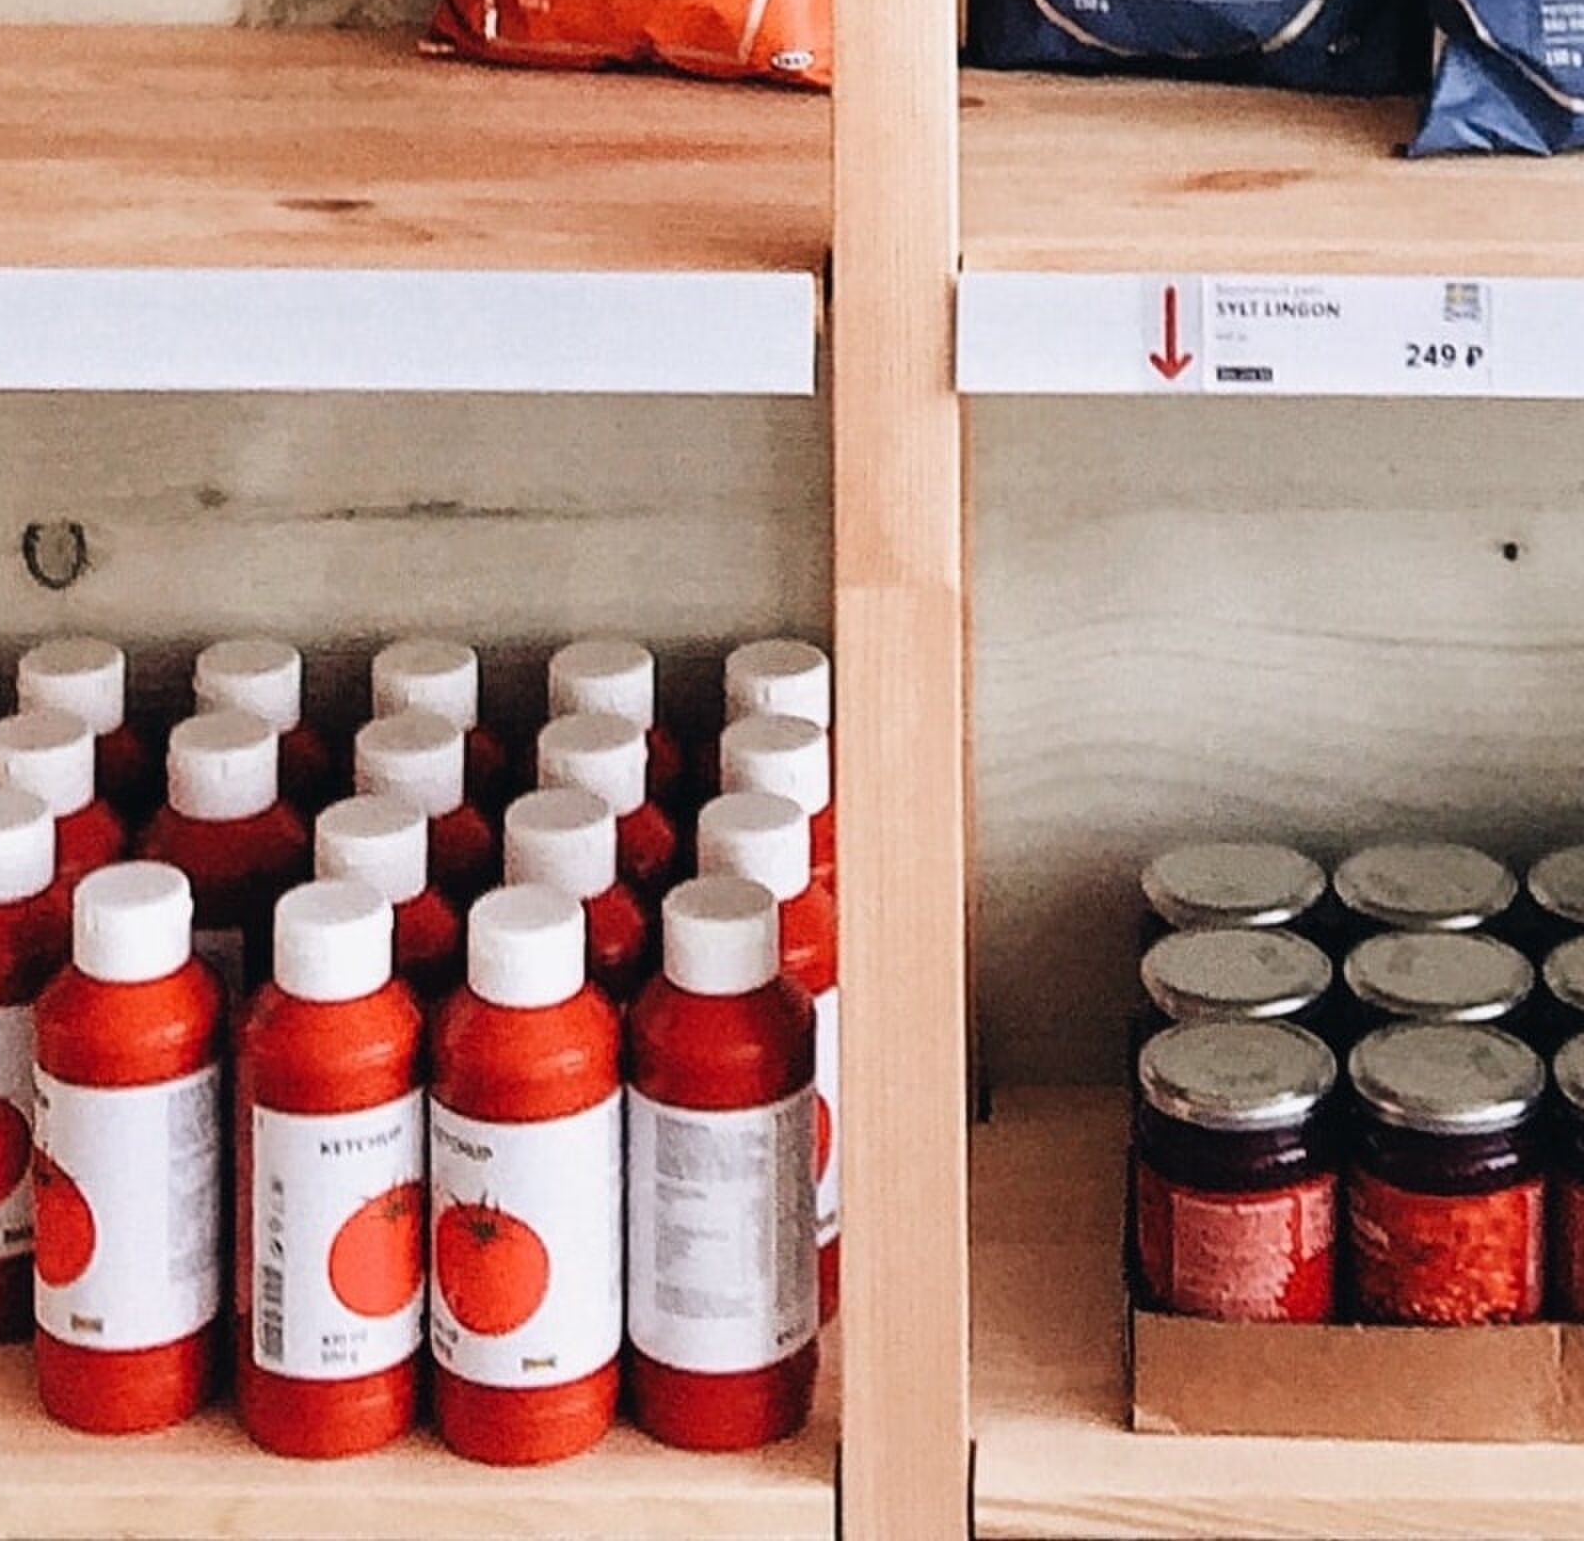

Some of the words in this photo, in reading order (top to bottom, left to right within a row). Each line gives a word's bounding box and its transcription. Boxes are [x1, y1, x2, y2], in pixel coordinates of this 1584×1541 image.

[1215, 301, 1261, 319] SYLT
[1264, 301, 1342, 320] LINGON
[1404, 343, 1457, 368] 249
